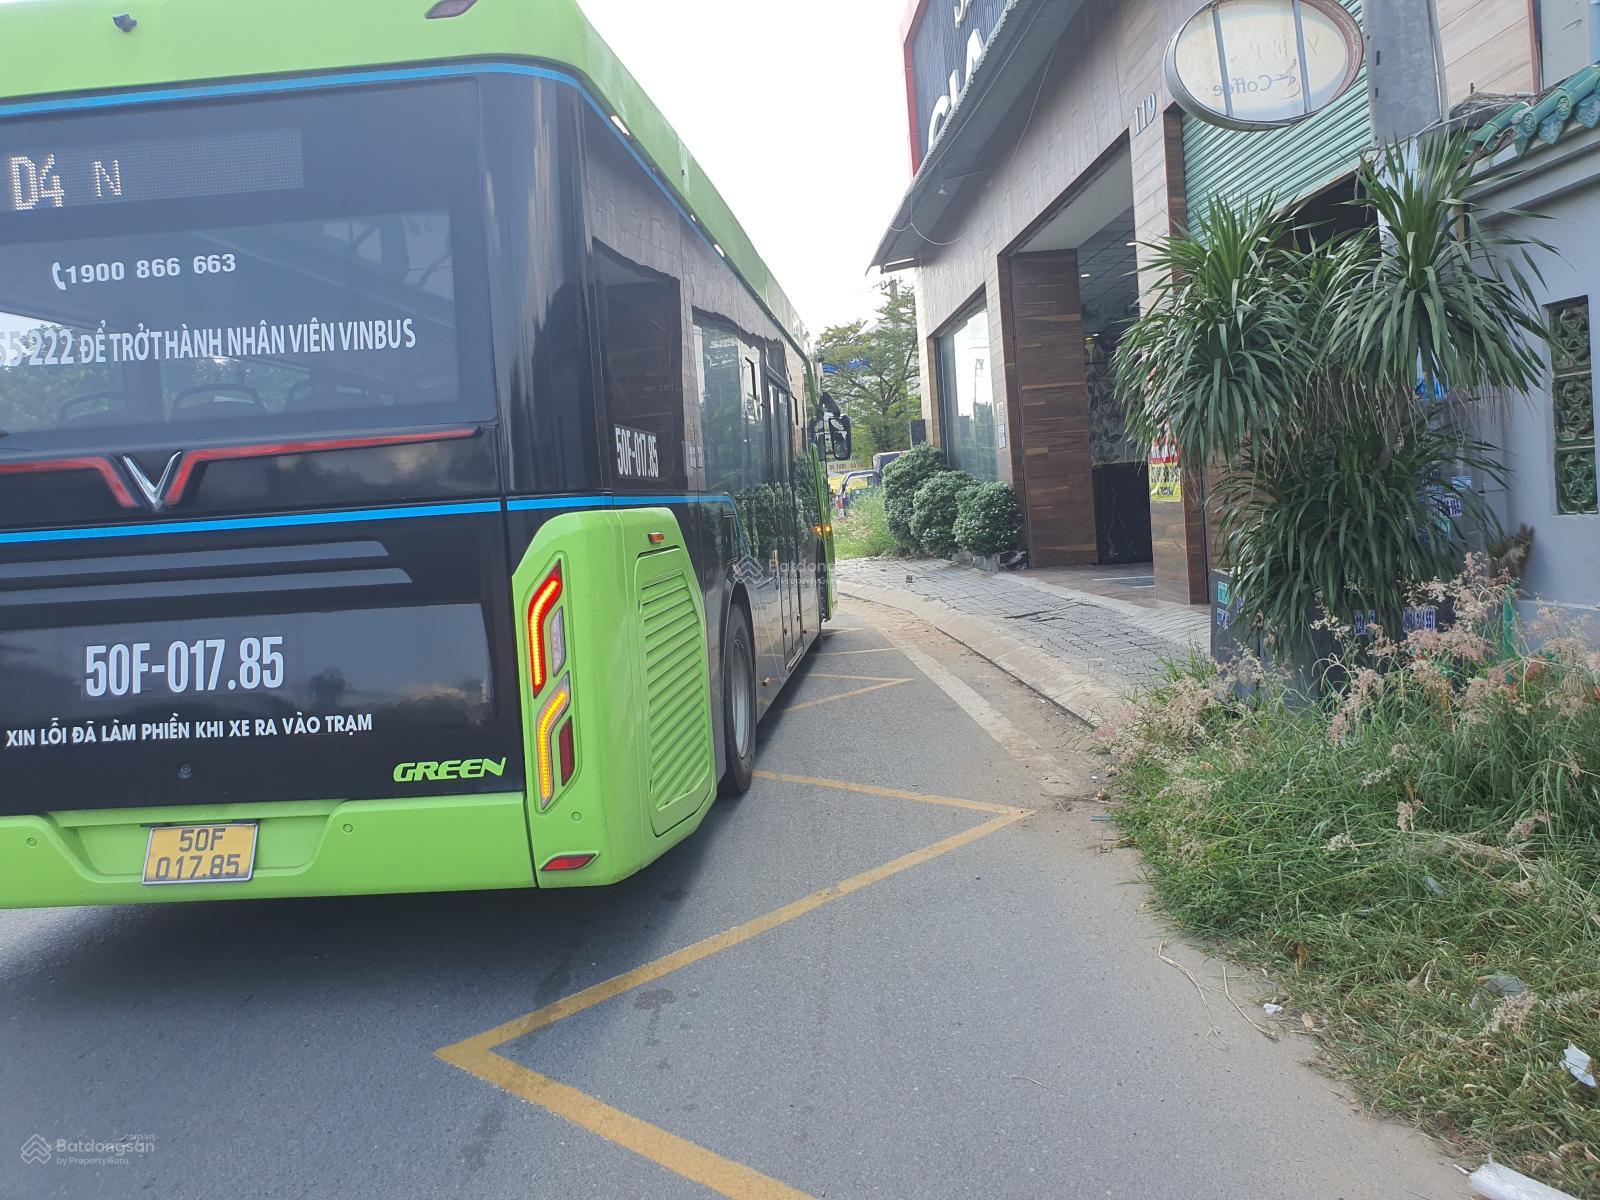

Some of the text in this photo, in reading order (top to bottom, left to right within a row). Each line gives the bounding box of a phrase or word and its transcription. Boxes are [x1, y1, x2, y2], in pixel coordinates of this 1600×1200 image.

[10, 153, 122, 210] D4 N
[65, 253, 236, 284] 1900 866 663
[79, 319, 107, 364] ĐỂ
[227, 319, 285, 356] NHÂN
[288, 316, 335, 353] VIÊN
[339, 318, 416, 351] VINBUS
[614, 427, 659, 478] 50F-017.85
[86, 636, 285, 697] 50F-017.85
[6, 711, 373, 747] XIN LỖI ĐÃ LÀM PHIỀN KHI XE RA VÀO TRẠM
[393, 757, 507, 782] GREEN
[179, 828, 226, 852] 50F
[155, 853, 241, 879] 017.85
